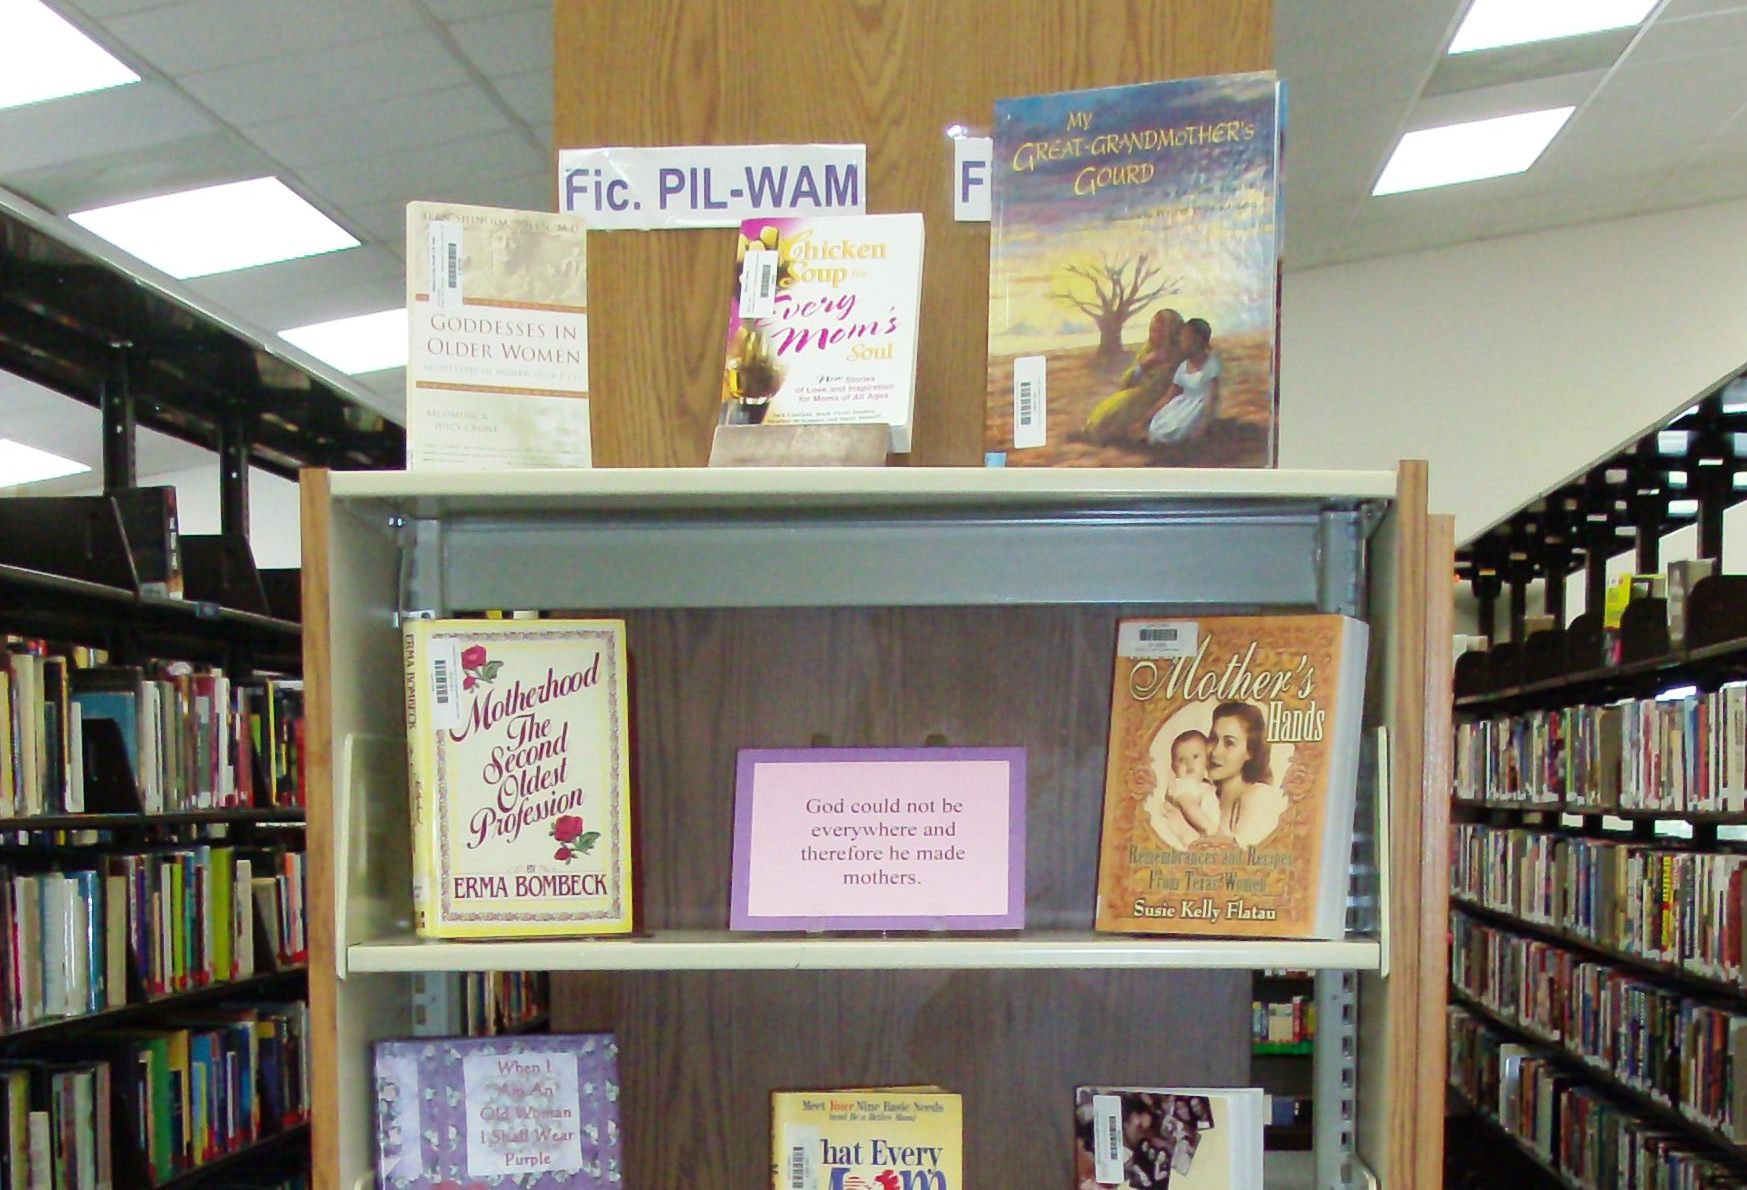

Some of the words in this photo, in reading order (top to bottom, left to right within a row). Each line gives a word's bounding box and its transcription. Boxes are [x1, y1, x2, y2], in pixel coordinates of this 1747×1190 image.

[1067, 112, 1092, 131] MY
[566, 168, 641, 212] Fic.
[659, 164, 858, 209] PIL-WAM
[1074, 164, 1154, 196] GOURD
[786, 229, 886, 263] Chicken
[779, 260, 847, 288] Soup
[431, 313, 545, 338] GODDESSES
[555, 325, 577, 340] IN
[770, 306, 899, 356] Mom's
[427, 338, 494, 359] OLDER
[501, 343, 581, 364] WOMEN
[846, 343, 894, 361] Soul
[1129, 634, 1315, 700] Mother's
[449, 652, 600, 742] Motherhood
[507, 713, 551, 752] The
[1266, 701, 1325, 742] Hands
[483, 721, 568, 785] Second
[497, 758, 567, 814] Oldest
[467, 788, 584, 849] Profession
[806, 798, 844, 814] God
[850, 798, 900, 814] could
[907, 799, 935, 814] not
[942, 798, 963, 814] be
[811, 822, 917, 841] everywhere
[923, 822, 956, 837] and
[801, 845, 883, 861] therefore
[889, 845, 909, 861] he
[916, 845, 966, 861] made
[454, 877, 508, 898] ERMA
[516, 873, 607, 897] BOMBECK
[843, 869, 922, 885] mothers.
[1134, 899, 1176, 918] Susie
[1180, 899, 1221, 923] Kelly
[498, 1060, 540, 1073] When
[479, 1107, 509, 1121] Old
[914, 1102, 944, 1113] Needs
[535, 1129, 573, 1142] Wear
[504, 1152, 552, 1167] Purple
[820, 1138, 864, 1165] hat
[871, 1139, 943, 1172] Every
